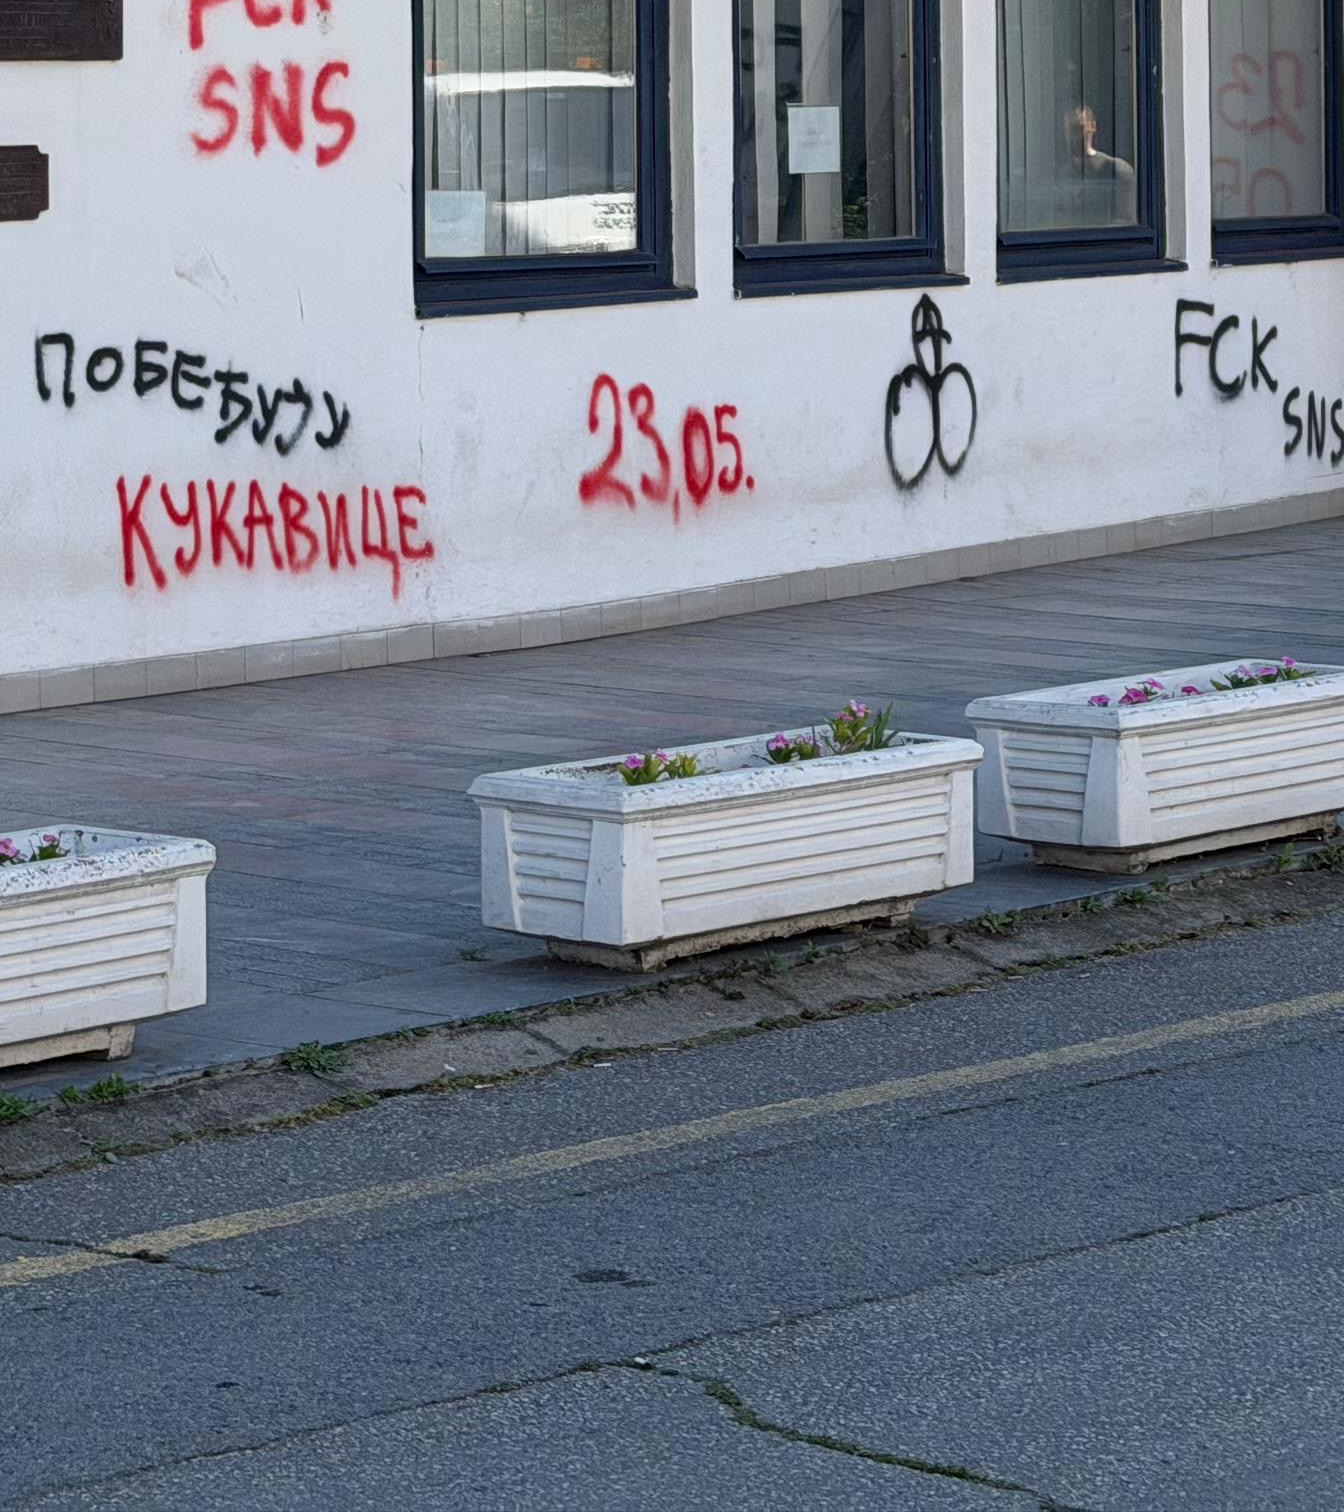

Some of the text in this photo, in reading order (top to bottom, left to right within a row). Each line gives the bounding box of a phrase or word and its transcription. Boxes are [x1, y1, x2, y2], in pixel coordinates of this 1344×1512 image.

[189, 60, 357, 169] SNS
[1174, 298, 1278, 400] FCK
[114, 472, 438, 600] КУКАВИЦЕ
